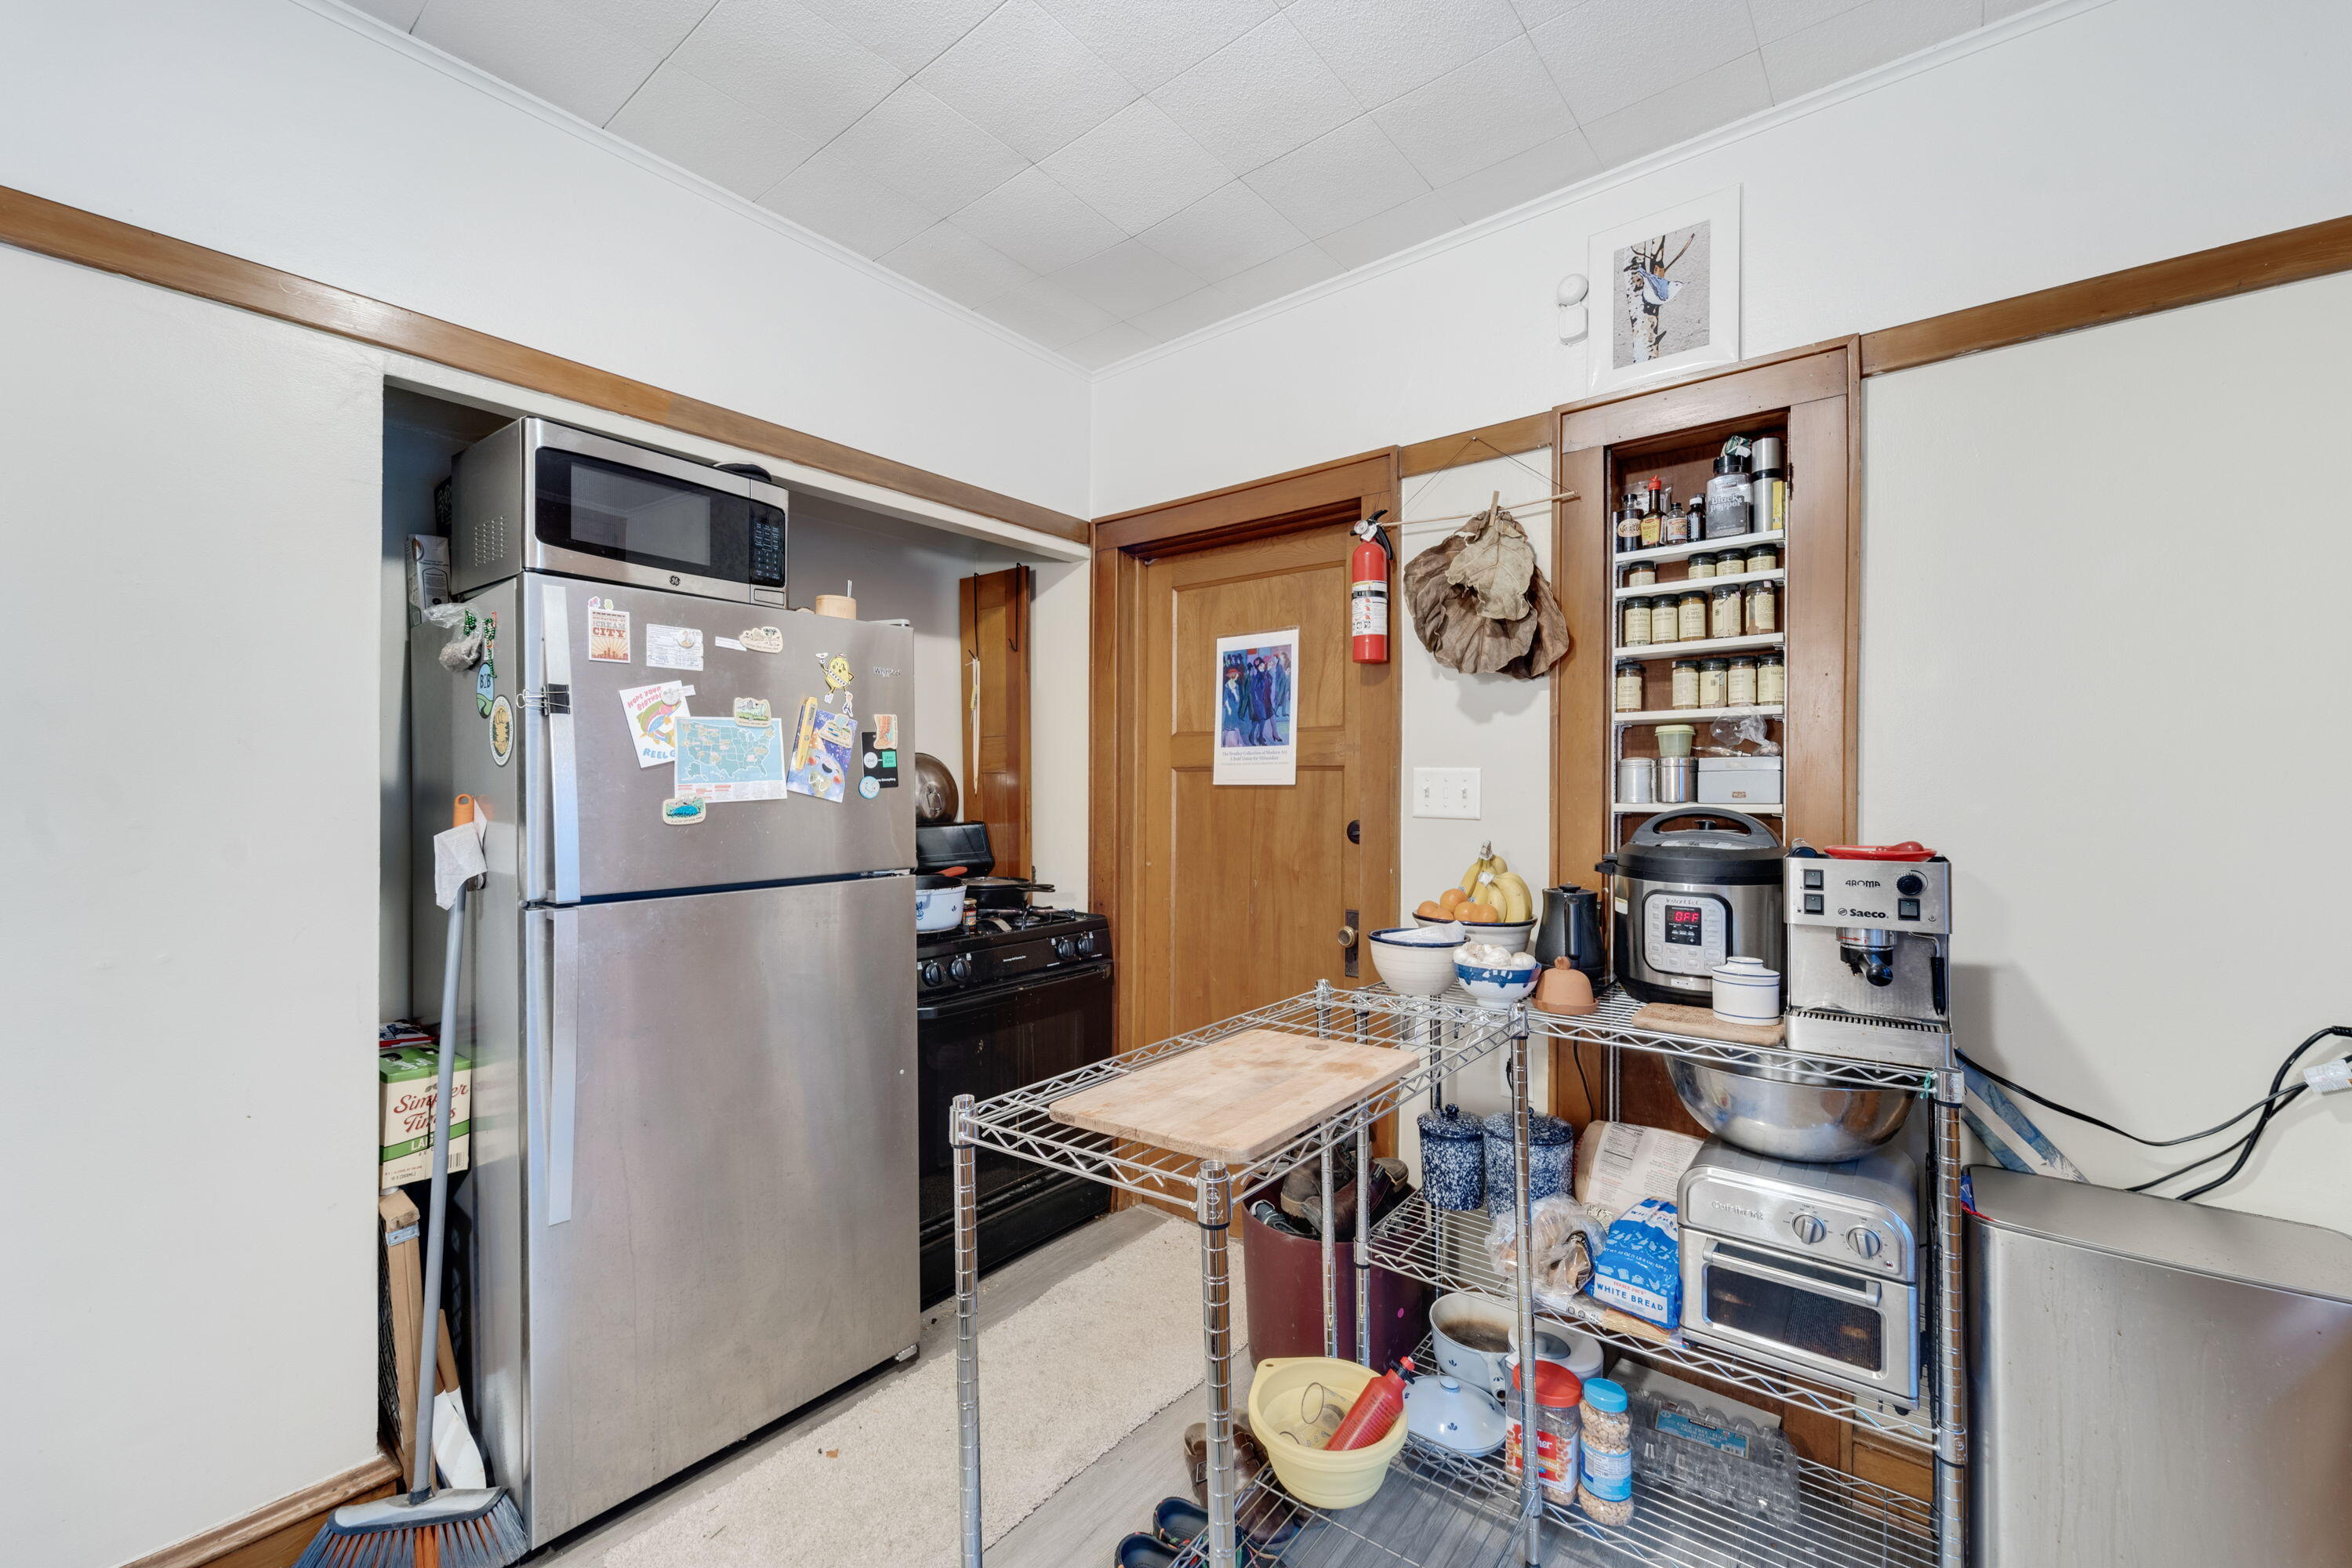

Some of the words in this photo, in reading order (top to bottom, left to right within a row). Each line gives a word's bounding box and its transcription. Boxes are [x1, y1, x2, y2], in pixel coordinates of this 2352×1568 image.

[1710, 499, 1742, 514] pepper
[1711, 494, 1738, 504] black
[593, 627, 626, 638] CITY
[627, 693, 644, 708] HOPE
[644, 686, 662, 697] YOUR
[637, 693, 662, 711] BIRTHD
[643, 748, 668, 759] REEL
[1846, 880, 1881, 888] AROMA
[1675, 910, 1699, 922] OFF
[1849, 909, 1886, 919] Saeco
[394, 1083, 469, 1113] Simper
[404, 1108, 456, 1134] Tims
[411, 1134, 435, 1151] LAG
[1711, 1200, 1763, 1220] Cuisinart
[1613, 1281, 1631, 1291] TRADER
[1596, 1283, 1628, 1299] WHITE
[1631, 1294, 1664, 1311] BREAD
